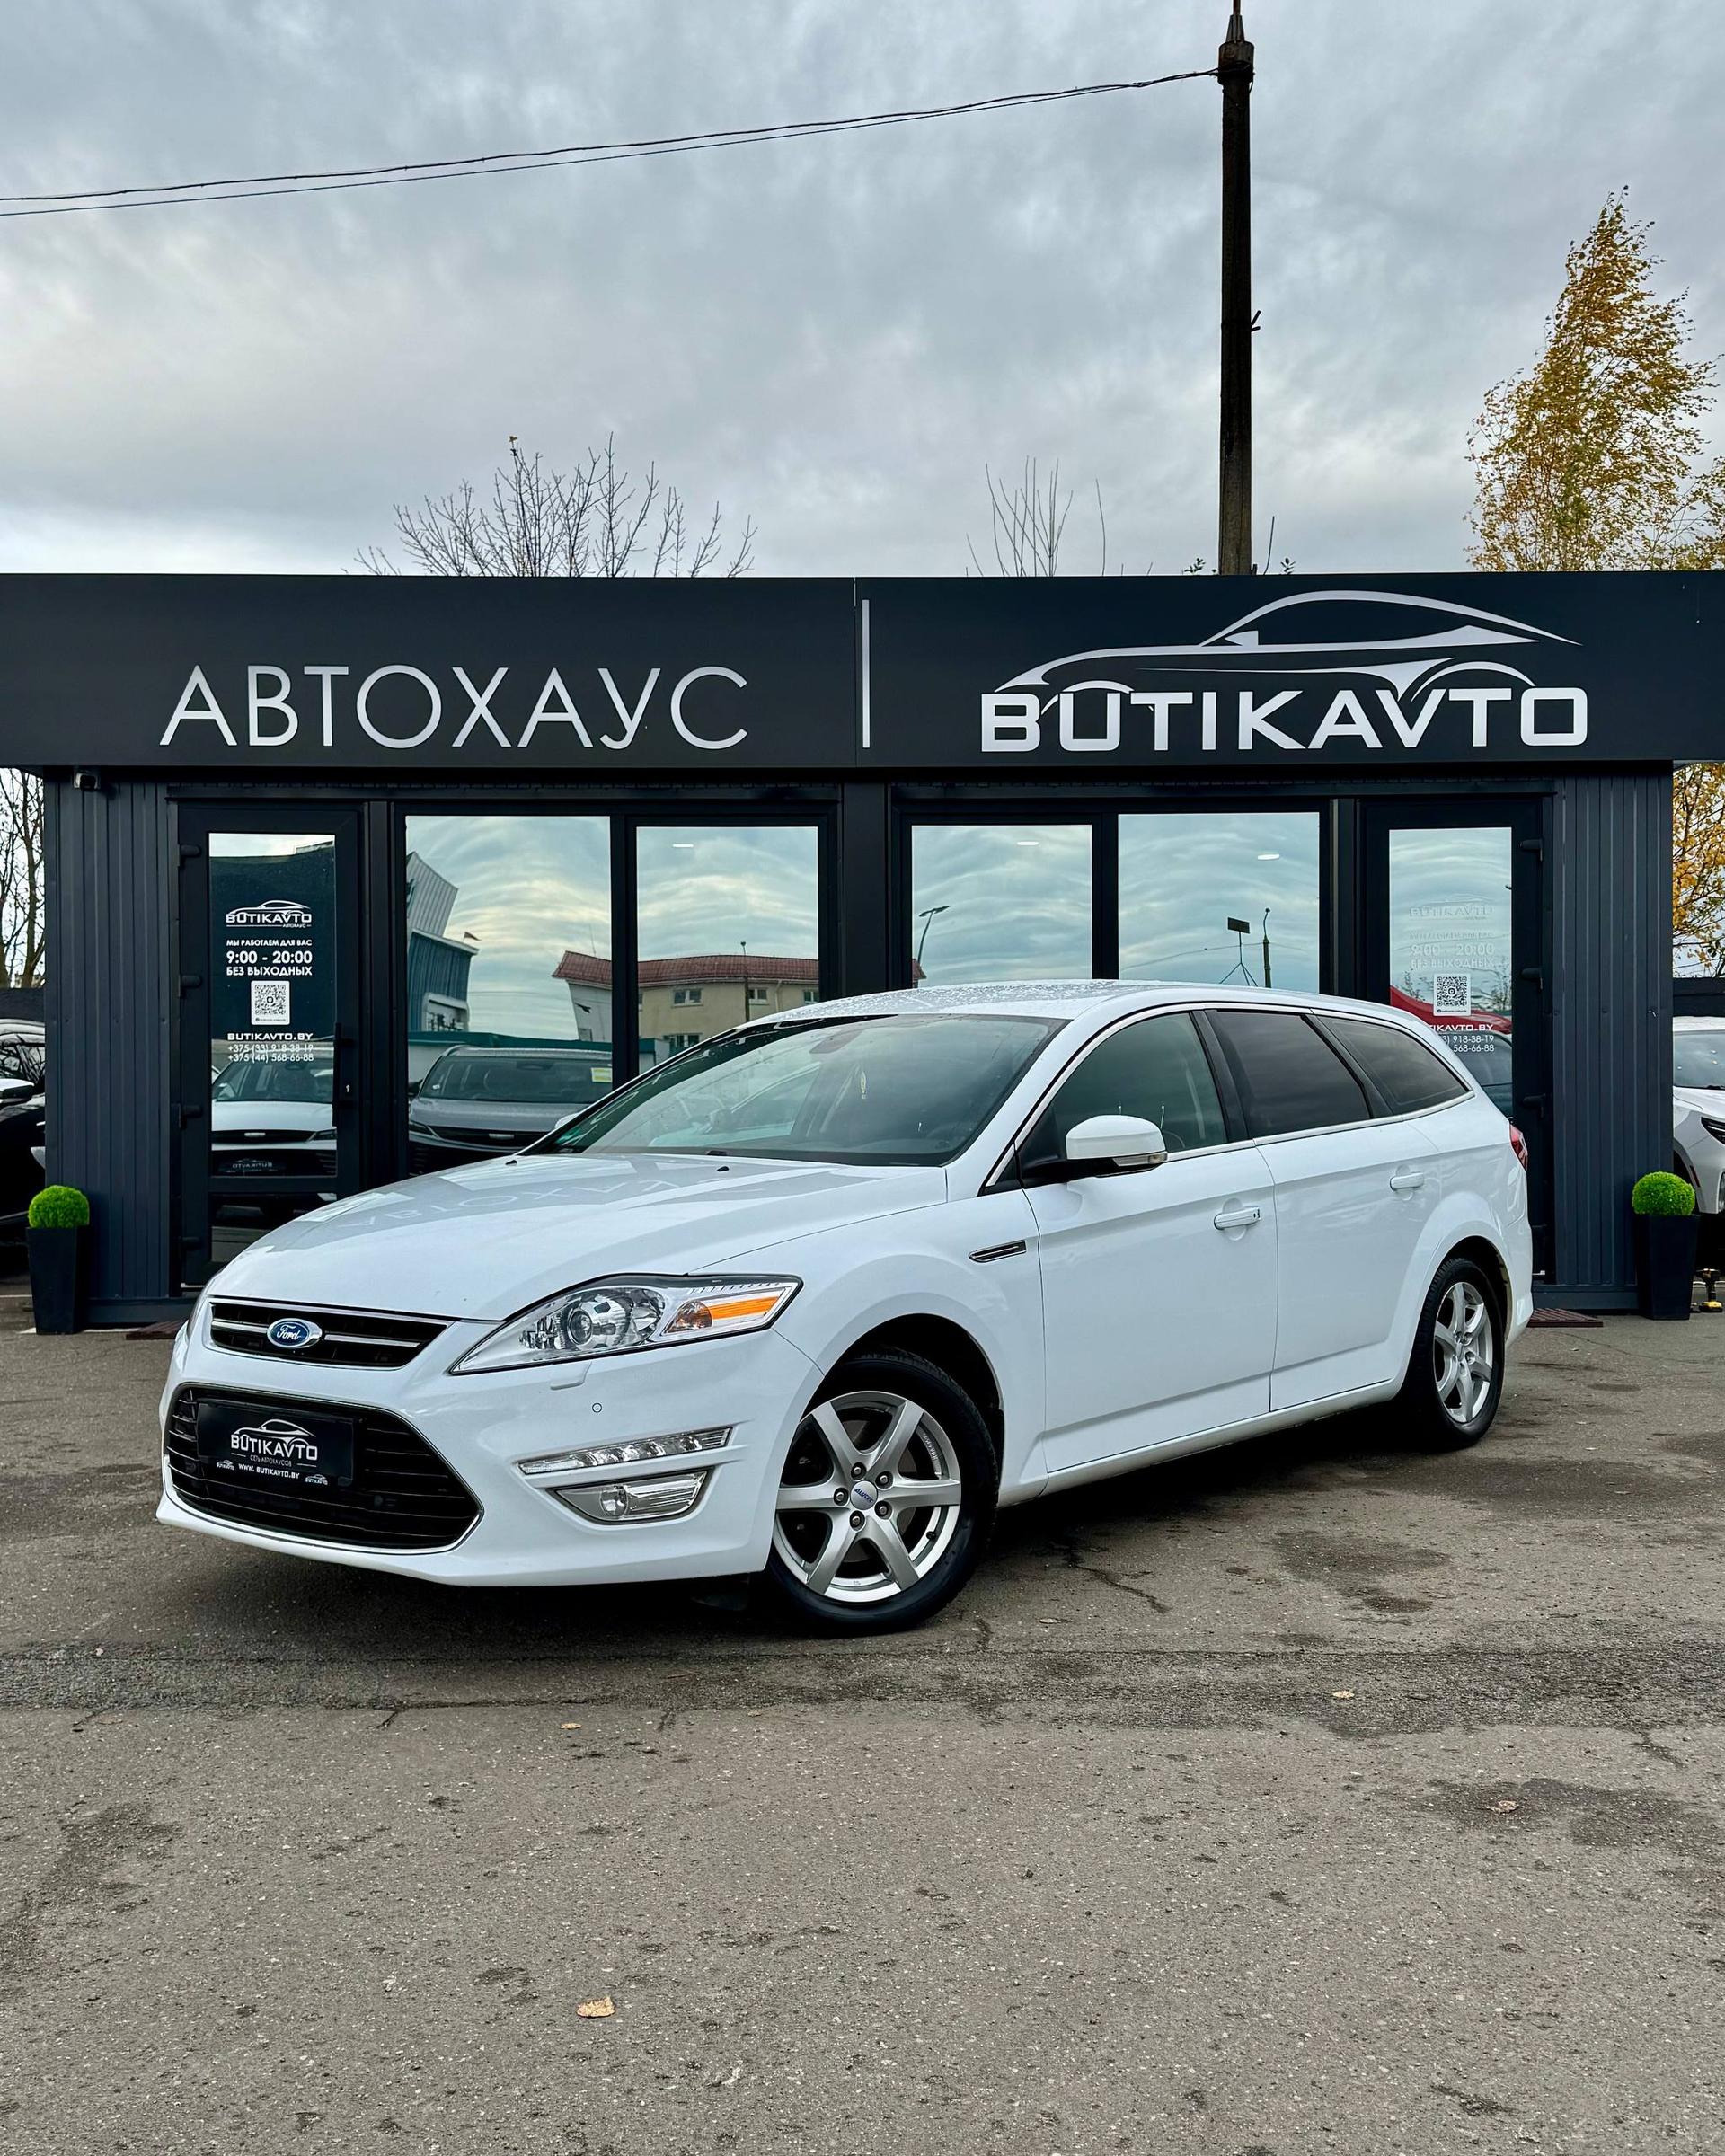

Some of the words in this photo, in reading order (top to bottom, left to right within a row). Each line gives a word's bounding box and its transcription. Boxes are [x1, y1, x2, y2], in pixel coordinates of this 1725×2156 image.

[159, 664, 748, 750] АВТОХАУС
[981, 686, 1588, 752] BUTIKAVTO
[226, 913, 312, 923] BUTIKAVTO
[1455, 943, 1495, 956] 20:00
[226, 950, 258, 964] 9:00
[272, 950, 313, 964] 20:00
[226, 966, 244, 976] БЕЗ
[247, 966, 313, 976] ВЫХОДНЫХ
[1453, 1035, 1495, 1043] 918-38-19
[228, 1044, 250, 1053] +375
[252, 1044, 269, 1054] (33)
[271, 1044, 314, 1053] 918-38-19
[1453, 1044, 1495, 1052] 568-66-88
[228, 1053, 250, 1062] +375
[252, 1053, 269, 1064] (44)
[271, 1053, 314, 1062] 568-66-88
[276, 1324, 302, 1340] Ford
[231, 1434, 318, 1461] BUTIKAVTO
[256, 1466, 300, 1479] BUTIKAVTO.BY
